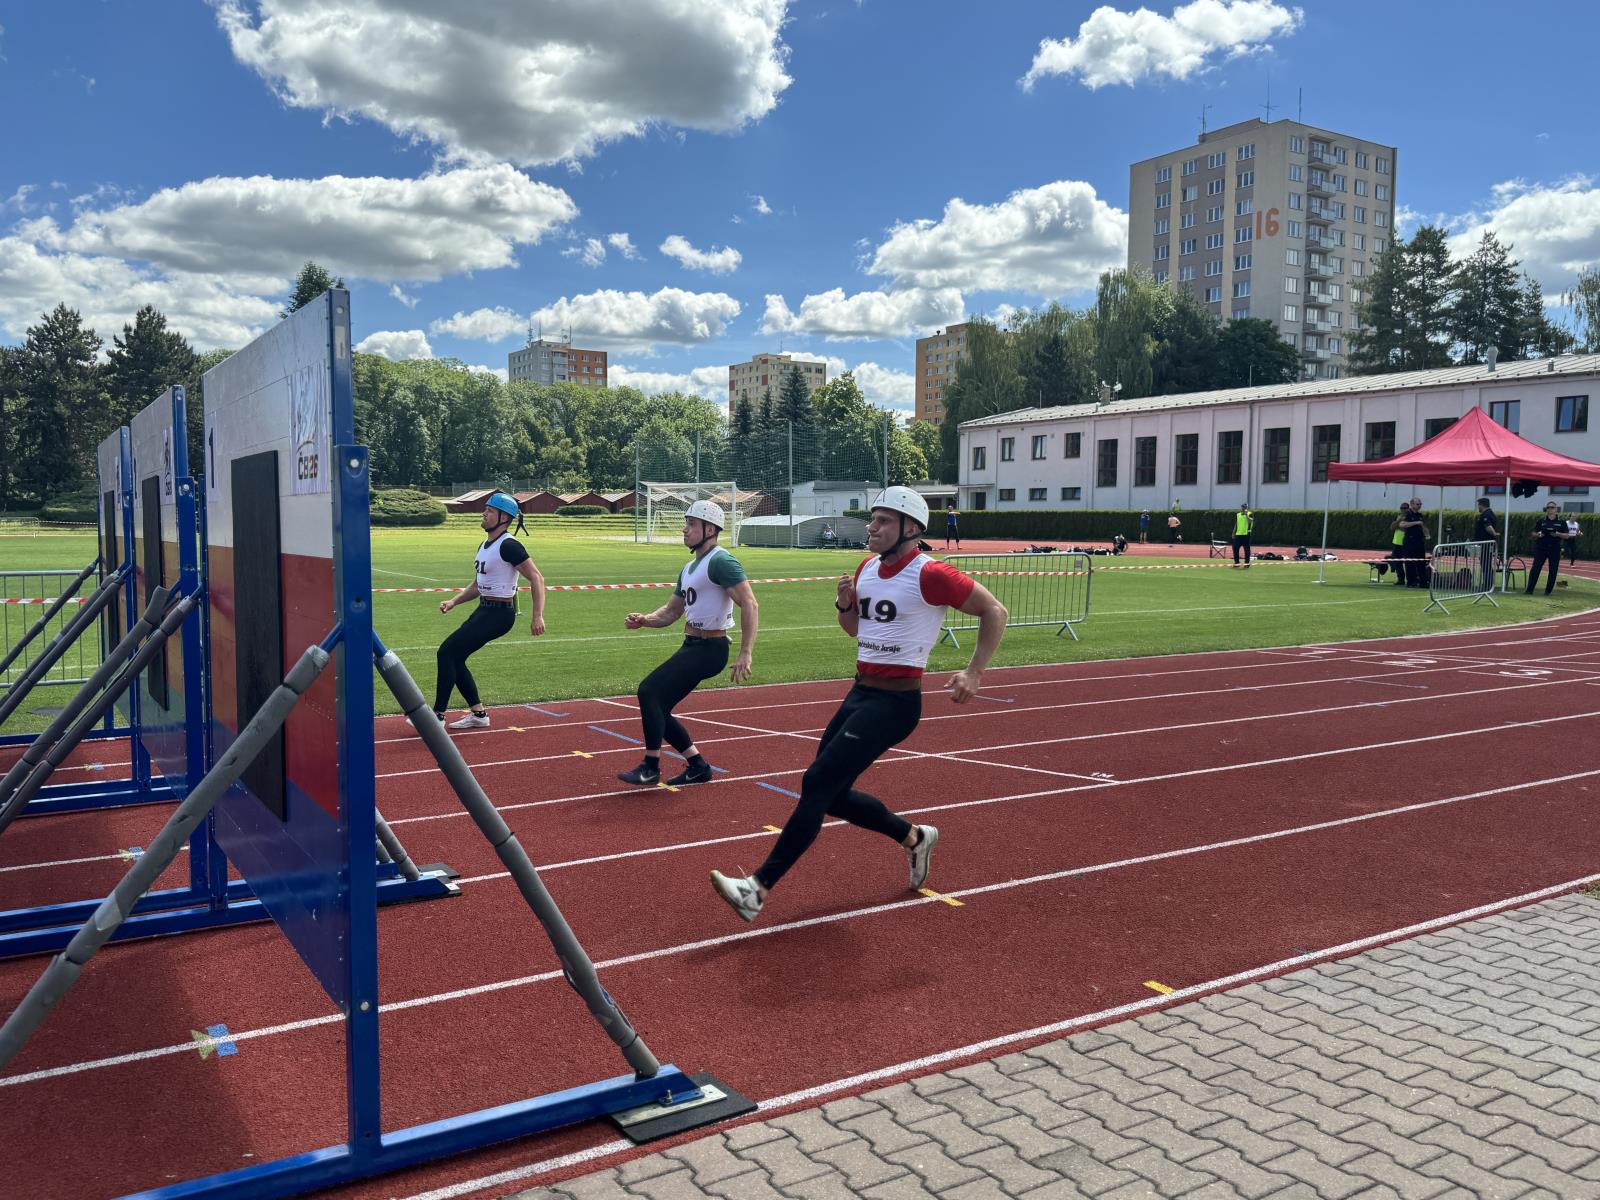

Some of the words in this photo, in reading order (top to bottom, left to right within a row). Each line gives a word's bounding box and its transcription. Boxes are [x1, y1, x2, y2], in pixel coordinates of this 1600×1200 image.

[1255, 207, 1280, 240] 16
[297, 451, 319, 480] ČB26
[474, 560, 487, 575] 21
[858, 596, 897, 623] 19
[880, 643, 901, 653] kraje
